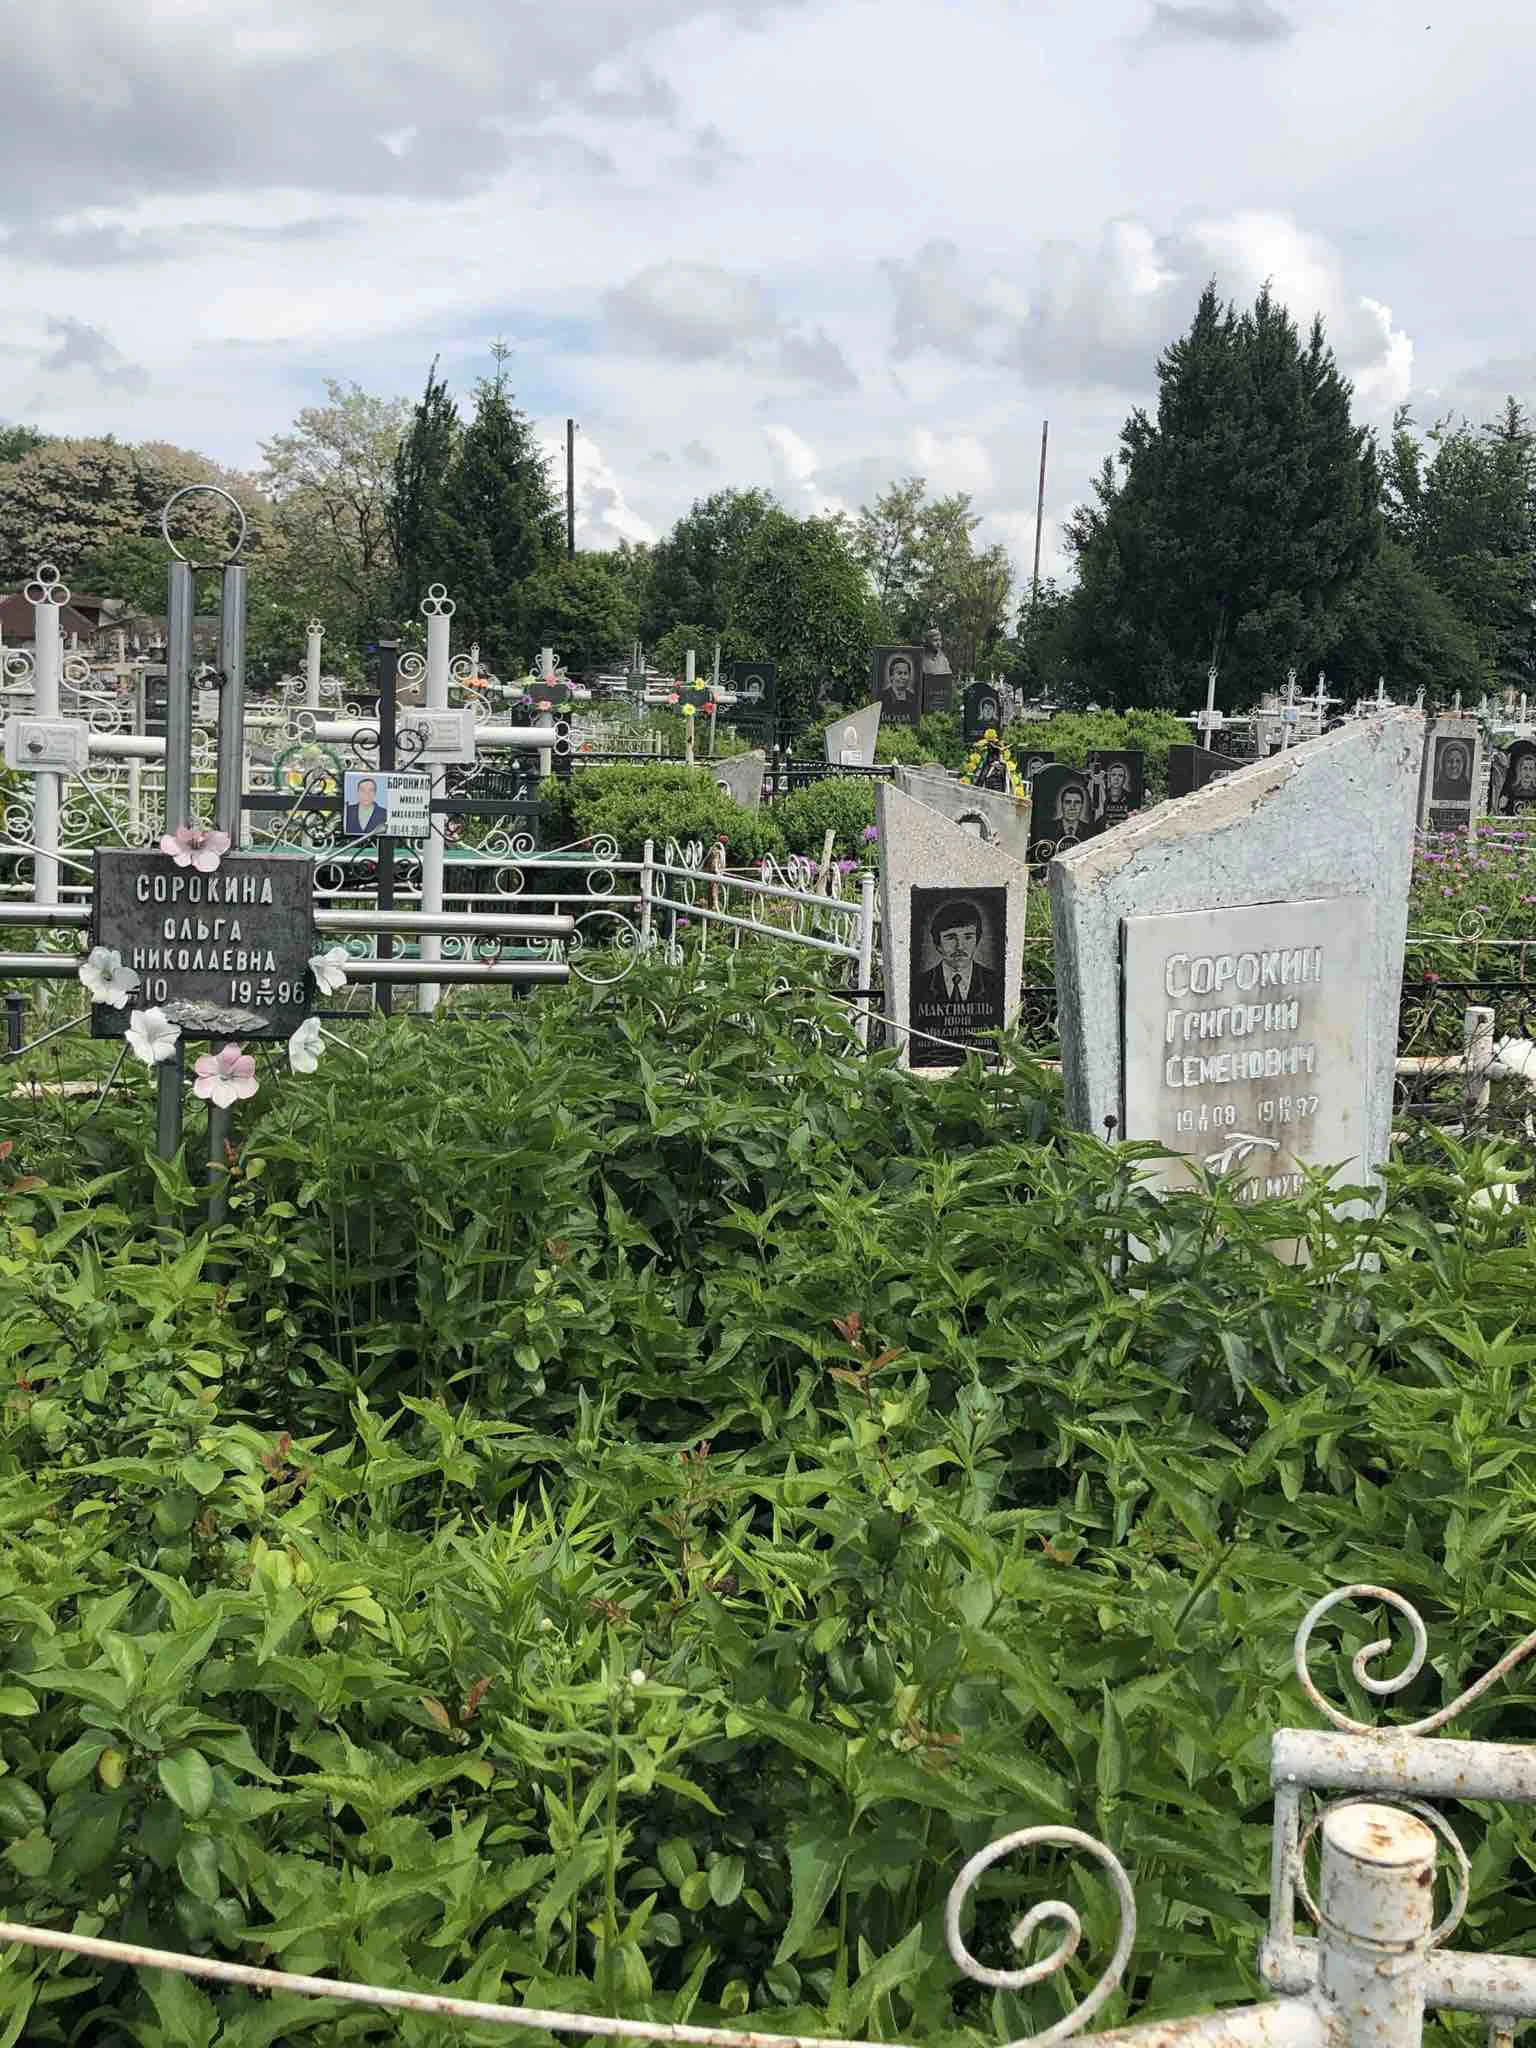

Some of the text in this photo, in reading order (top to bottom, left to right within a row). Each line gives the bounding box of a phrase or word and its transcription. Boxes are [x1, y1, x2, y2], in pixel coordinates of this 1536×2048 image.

[136, 874, 273, 905] СОРОКИНА
[163, 917, 242, 942] ОЛЬГА
[132, 948, 277, 972] НИКОЛАЕВНА
[1164, 944, 1323, 999] СОРОКИН
[1164, 994, 1300, 1043] ГРИГОРИЙ
[1164, 1043, 1317, 1089] СЕМЕНОВИЧ
